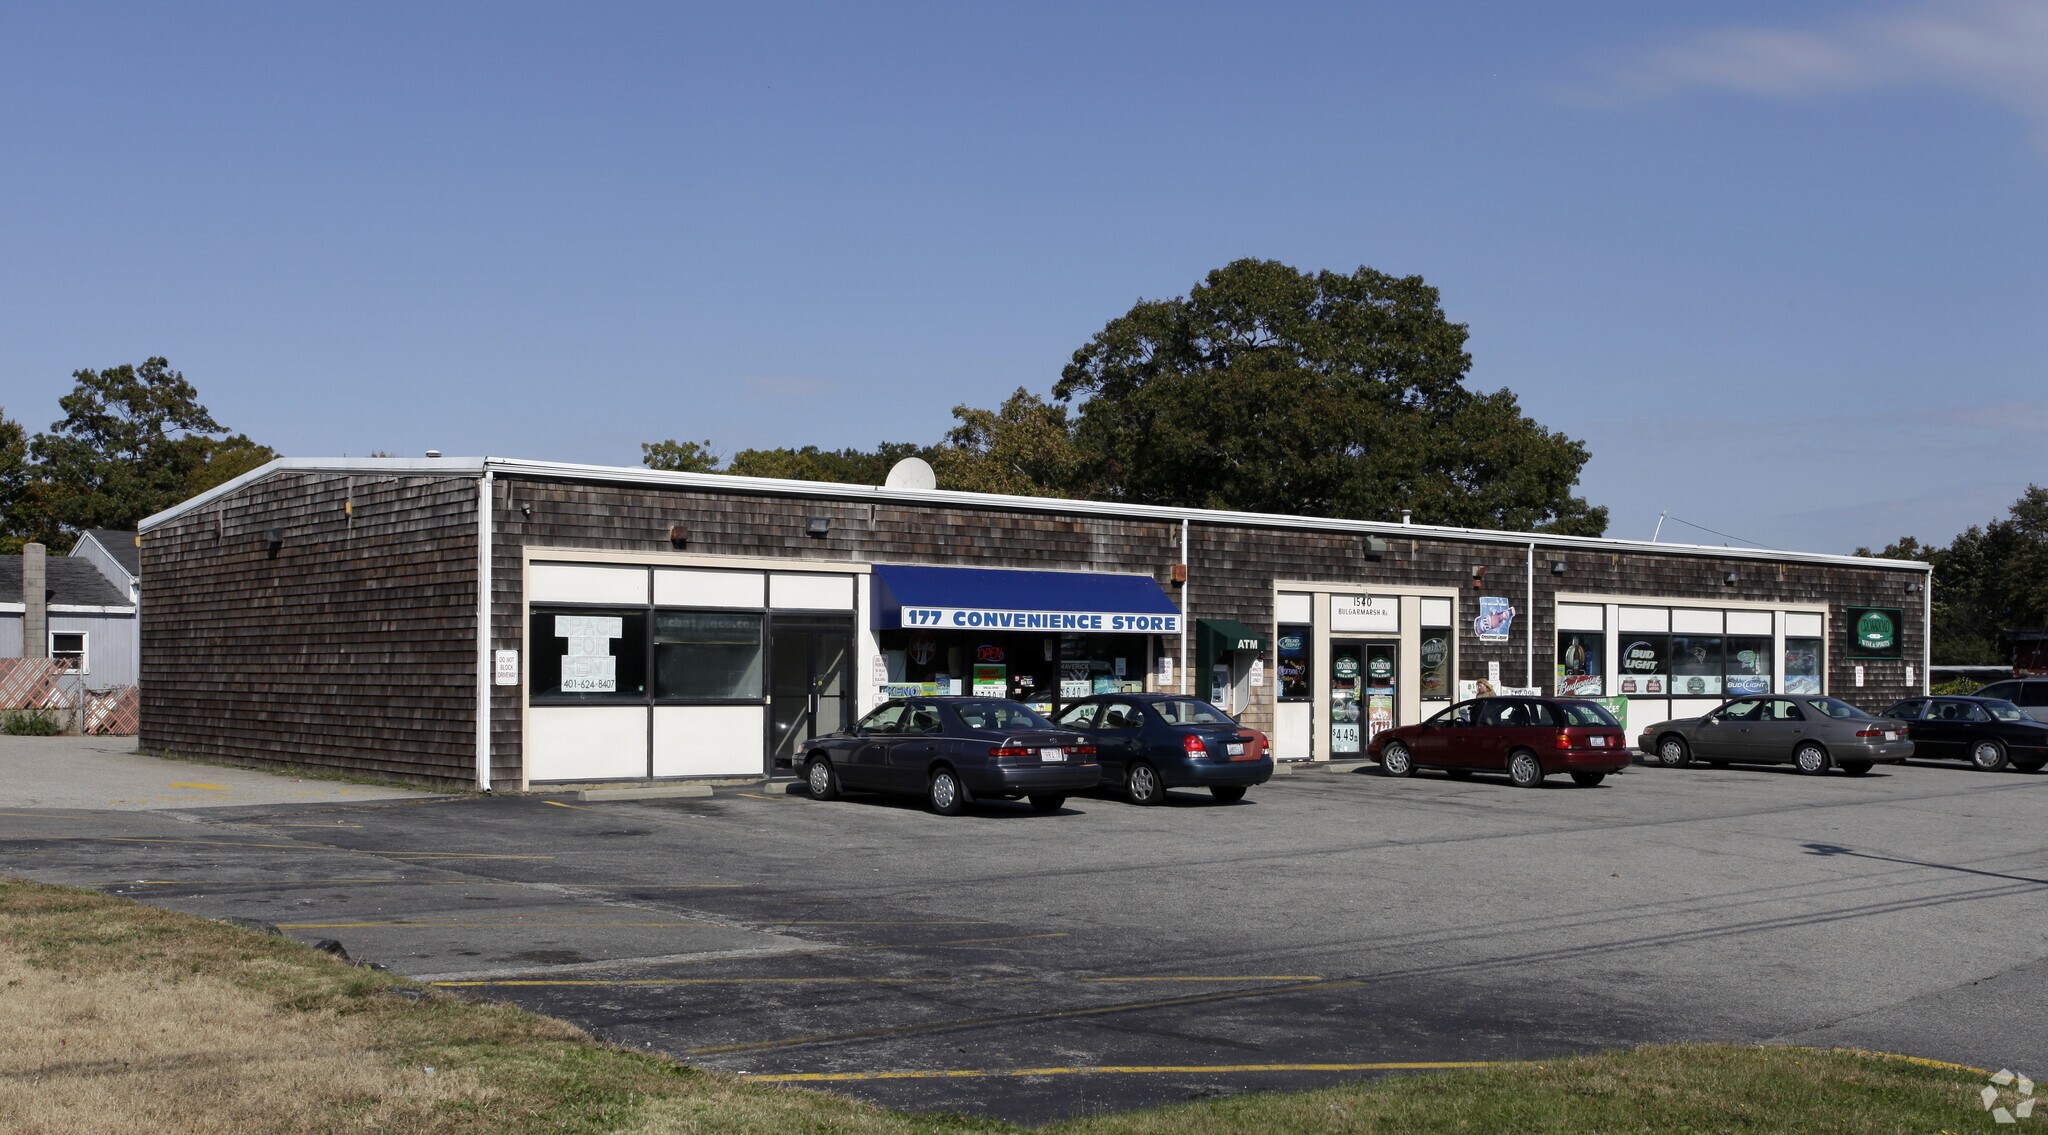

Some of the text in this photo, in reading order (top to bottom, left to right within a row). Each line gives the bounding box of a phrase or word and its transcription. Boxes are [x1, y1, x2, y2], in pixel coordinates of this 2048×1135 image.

[1353, 597, 1372, 607] 1540
[1338, 608, 1381, 616] BULGARMARSH
[908, 609, 1176, 631] 177 CONVENIENCE STORE
[556, 616, 620, 636] SPACE
[569, 637, 609, 655] FOR
[1237, 639, 1258, 649] ATM
[977, 646, 1003, 660] OPEN
[1630, 649, 1655, 659] BUD
[563, 656, 615, 675] RENT
[1625, 660, 1658, 670] LIGHT
[563, 679, 615, 689] 401-624-8407
[887, 685, 919, 697] KENO
